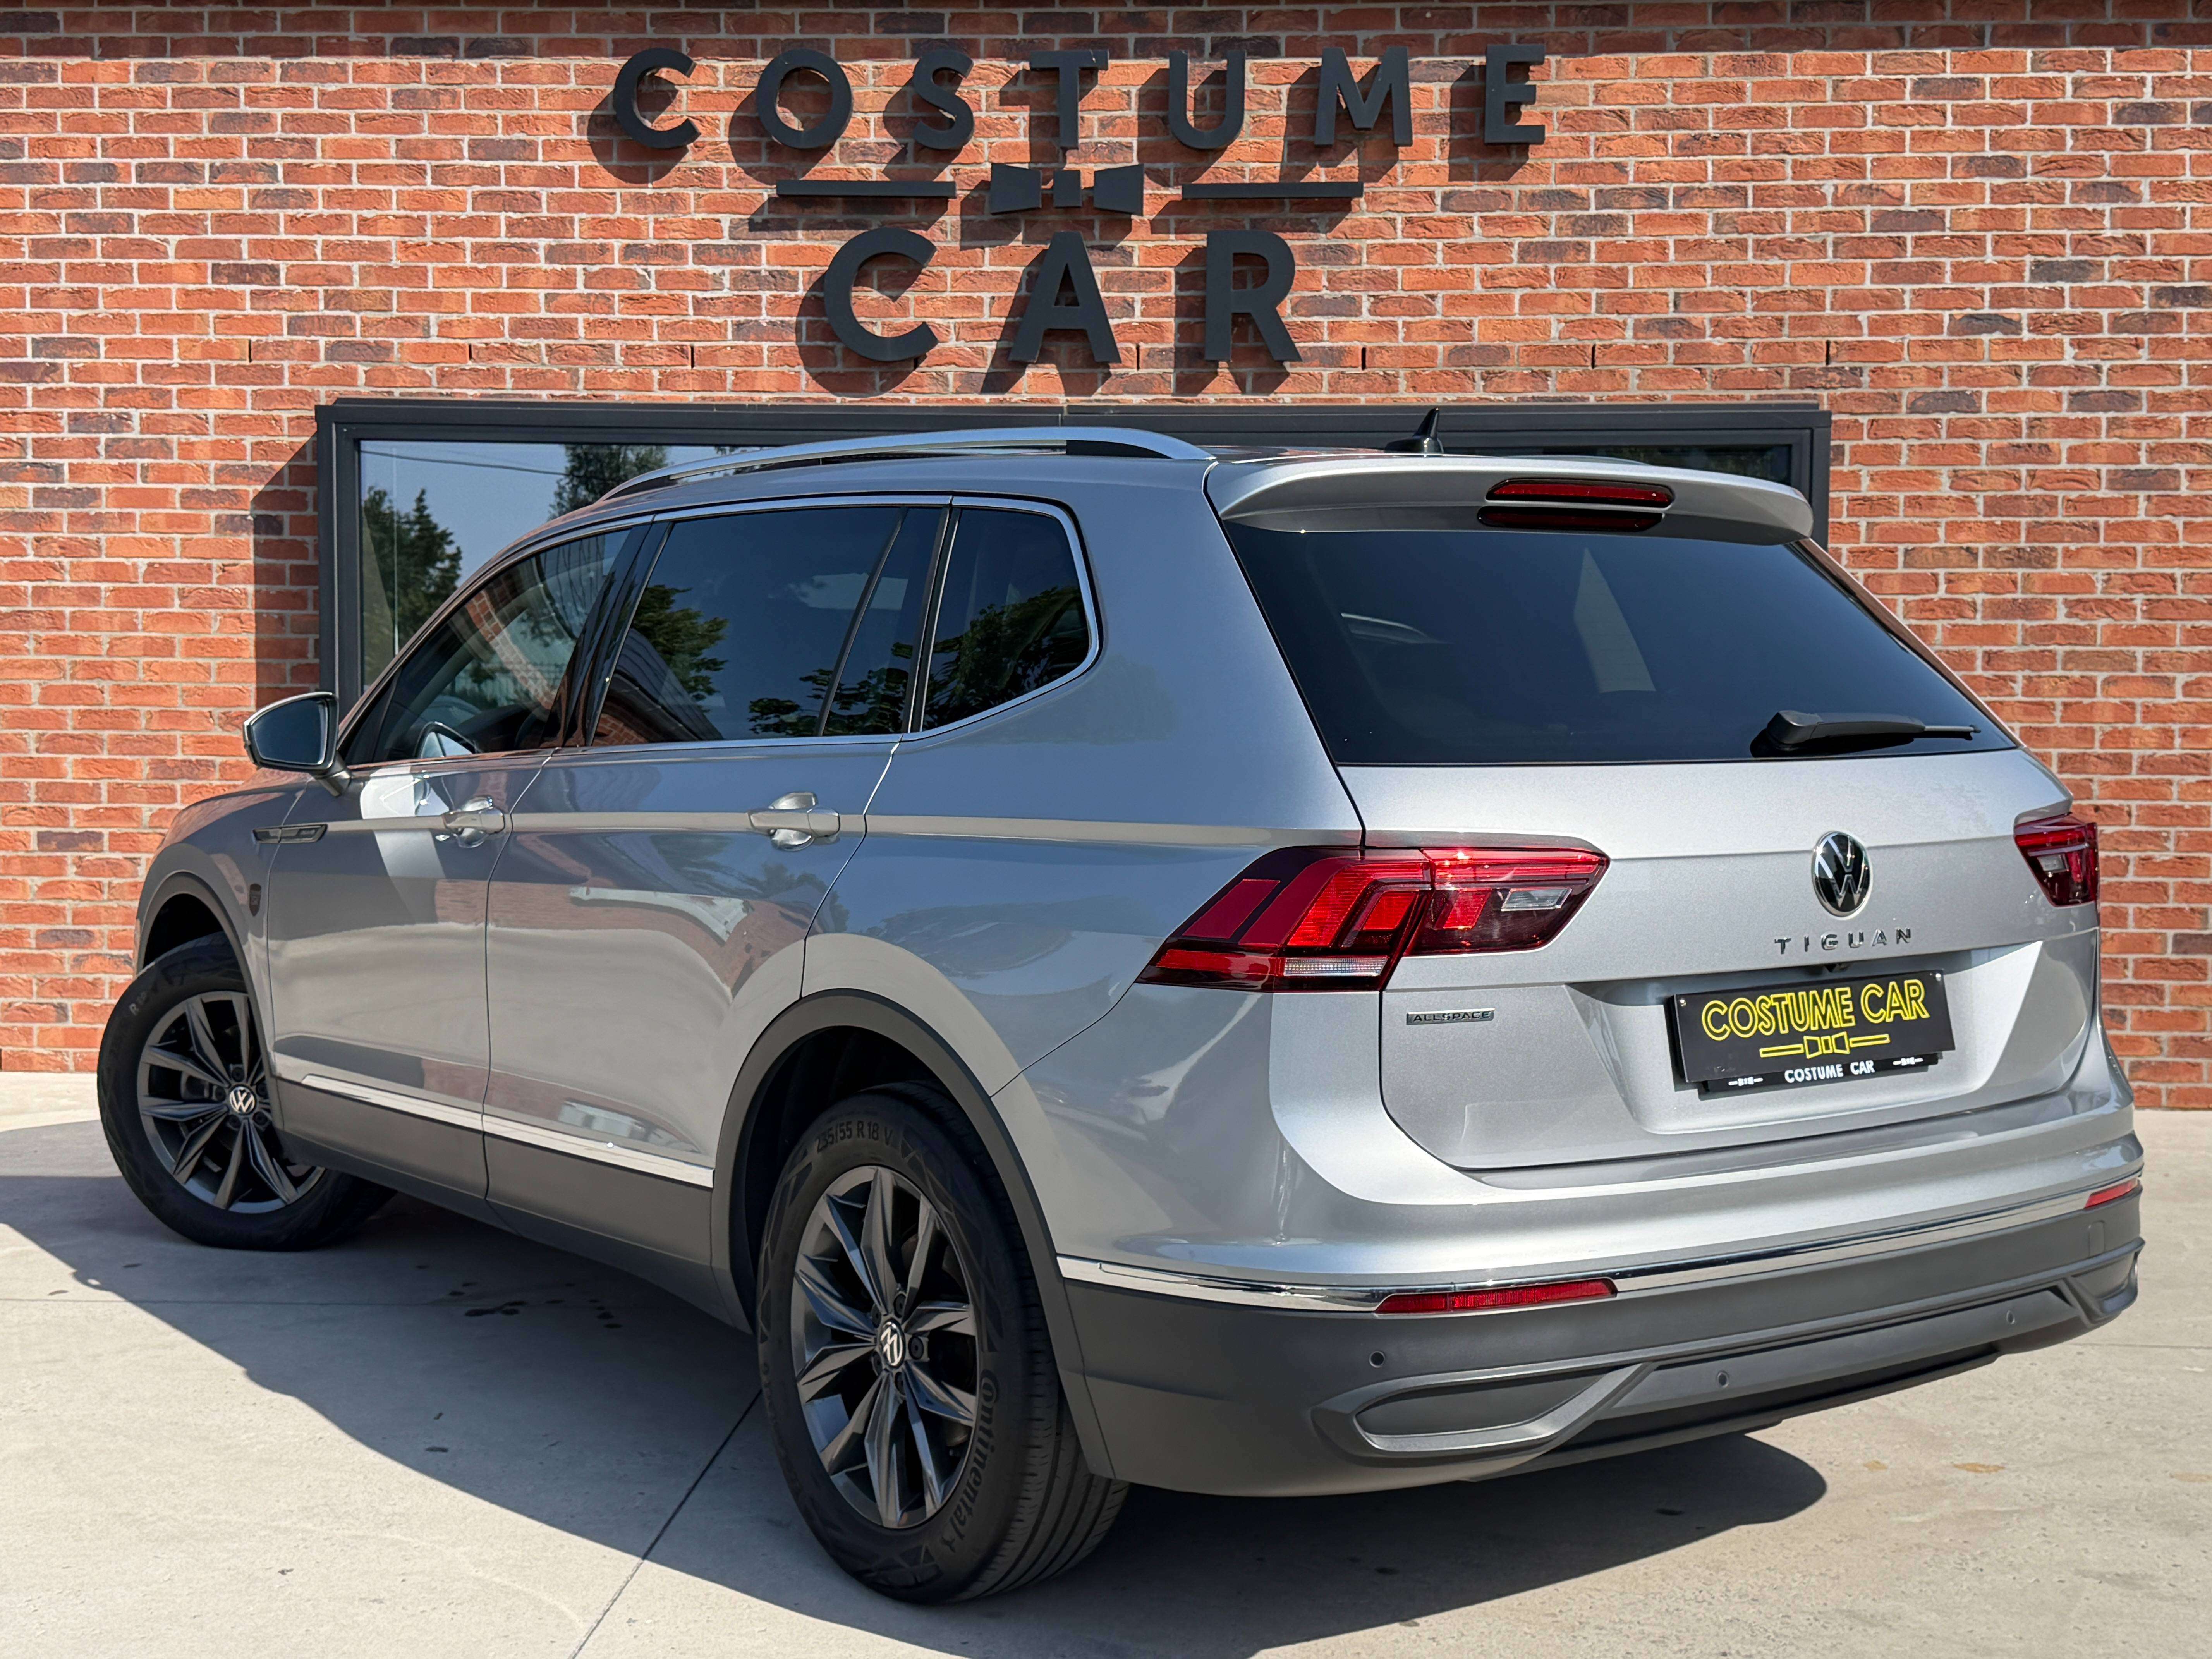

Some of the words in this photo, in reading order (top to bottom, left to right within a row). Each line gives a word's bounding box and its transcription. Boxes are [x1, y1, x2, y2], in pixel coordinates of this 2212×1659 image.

[613, 43, 1545, 150] COSTUME
[824, 227, 1302, 362] CAR
[1774, 927, 1911, 955] TIGUAN
[1413, 1010, 1491, 1022] ALLSPACE
[1702, 987, 1855, 1041] COSTUME
[1861, 979, 1929, 1023] CAR
[1784, 1064, 1844, 1084] COSTUME
[1850, 1060, 1875, 1075] CAR
[816, 1121, 853, 1153] 235/55
[857, 1120, 865, 1139] R
[867, 1121, 879, 1141] 18
[884, 1126, 893, 1146] V
[950, 1369, 1000, 1540] Continental
